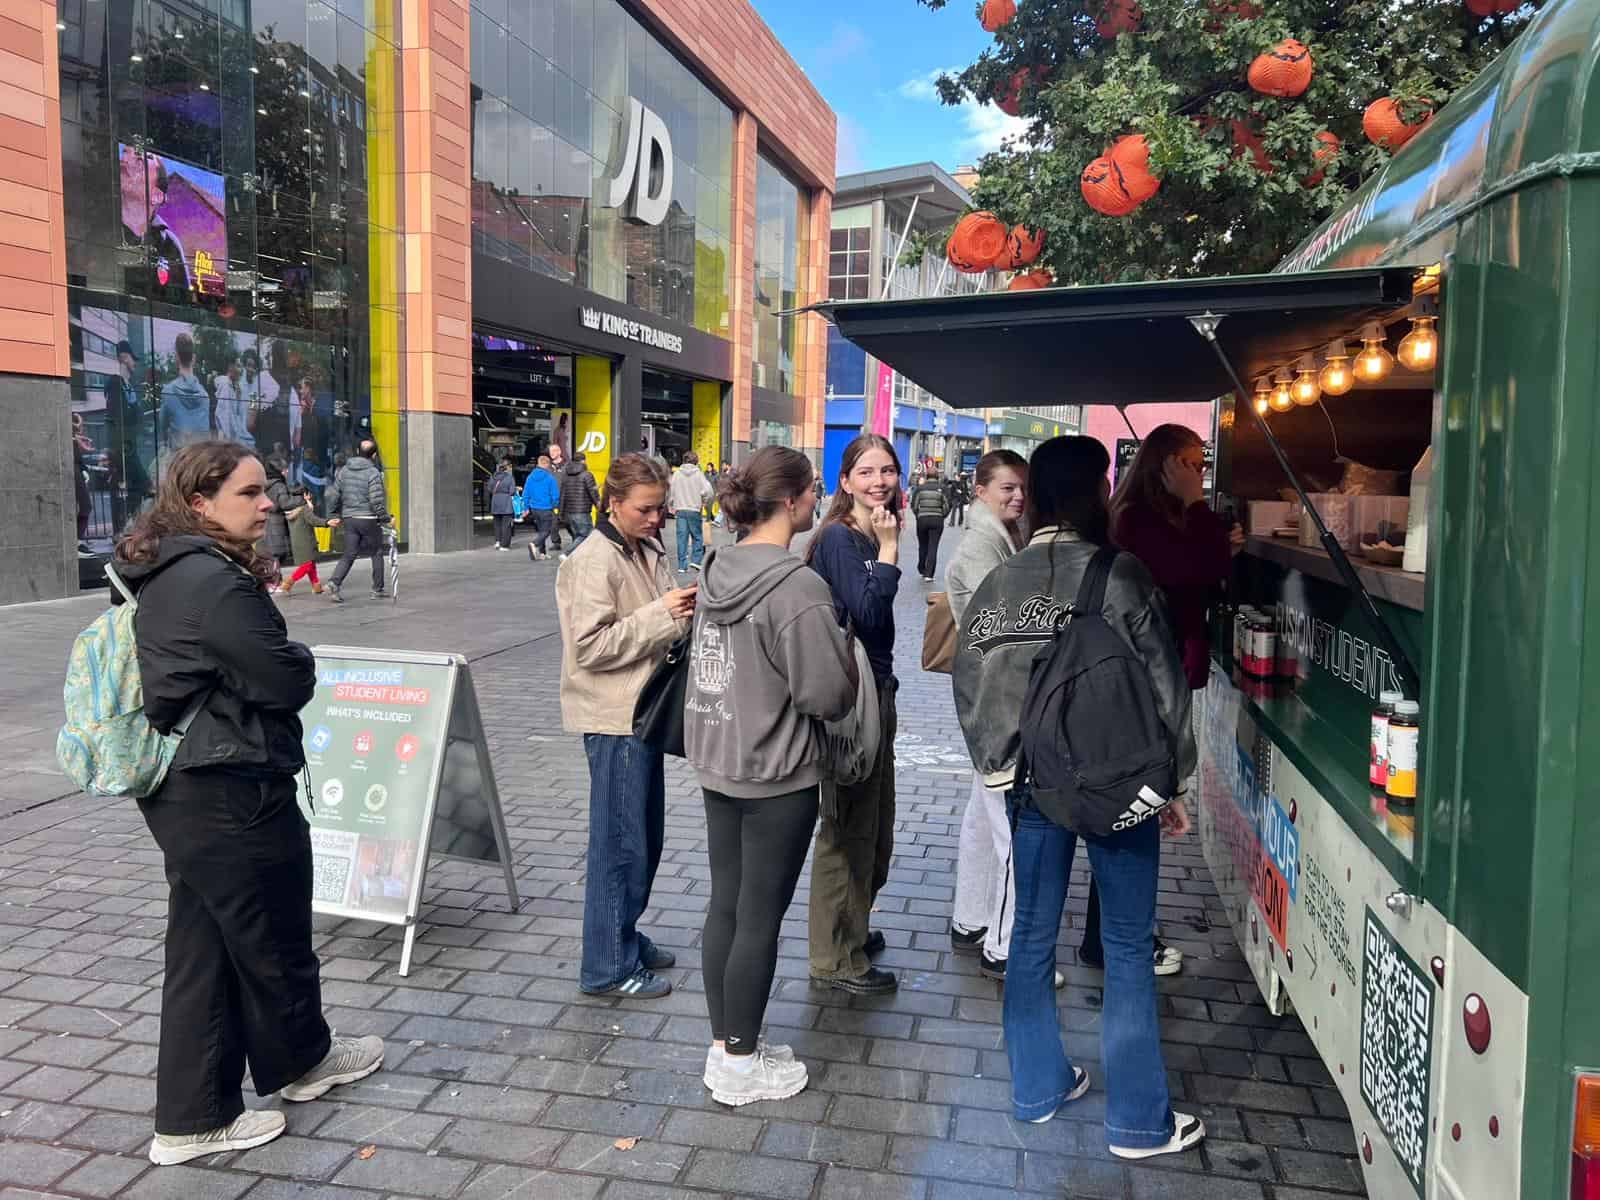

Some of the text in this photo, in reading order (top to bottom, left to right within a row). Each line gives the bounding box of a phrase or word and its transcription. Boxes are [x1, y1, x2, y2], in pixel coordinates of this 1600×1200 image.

[609, 96, 673, 225] JD
[602, 312, 682, 354] KING OF TRAINERS
[530, 373, 542, 383] LIFT
[576, 431, 607, 453] JD
[321, 671, 401, 682] ALL INCLUSIVE
[336, 685, 426, 703] STUDENT LIVING
[326, 705, 412, 722] WHAT'S INCLUDED
[1305, 852, 1320, 885] SCAN
[1304, 893, 1356, 987] FOR THE COOKIES
[1333, 914, 1350, 951] STAY
